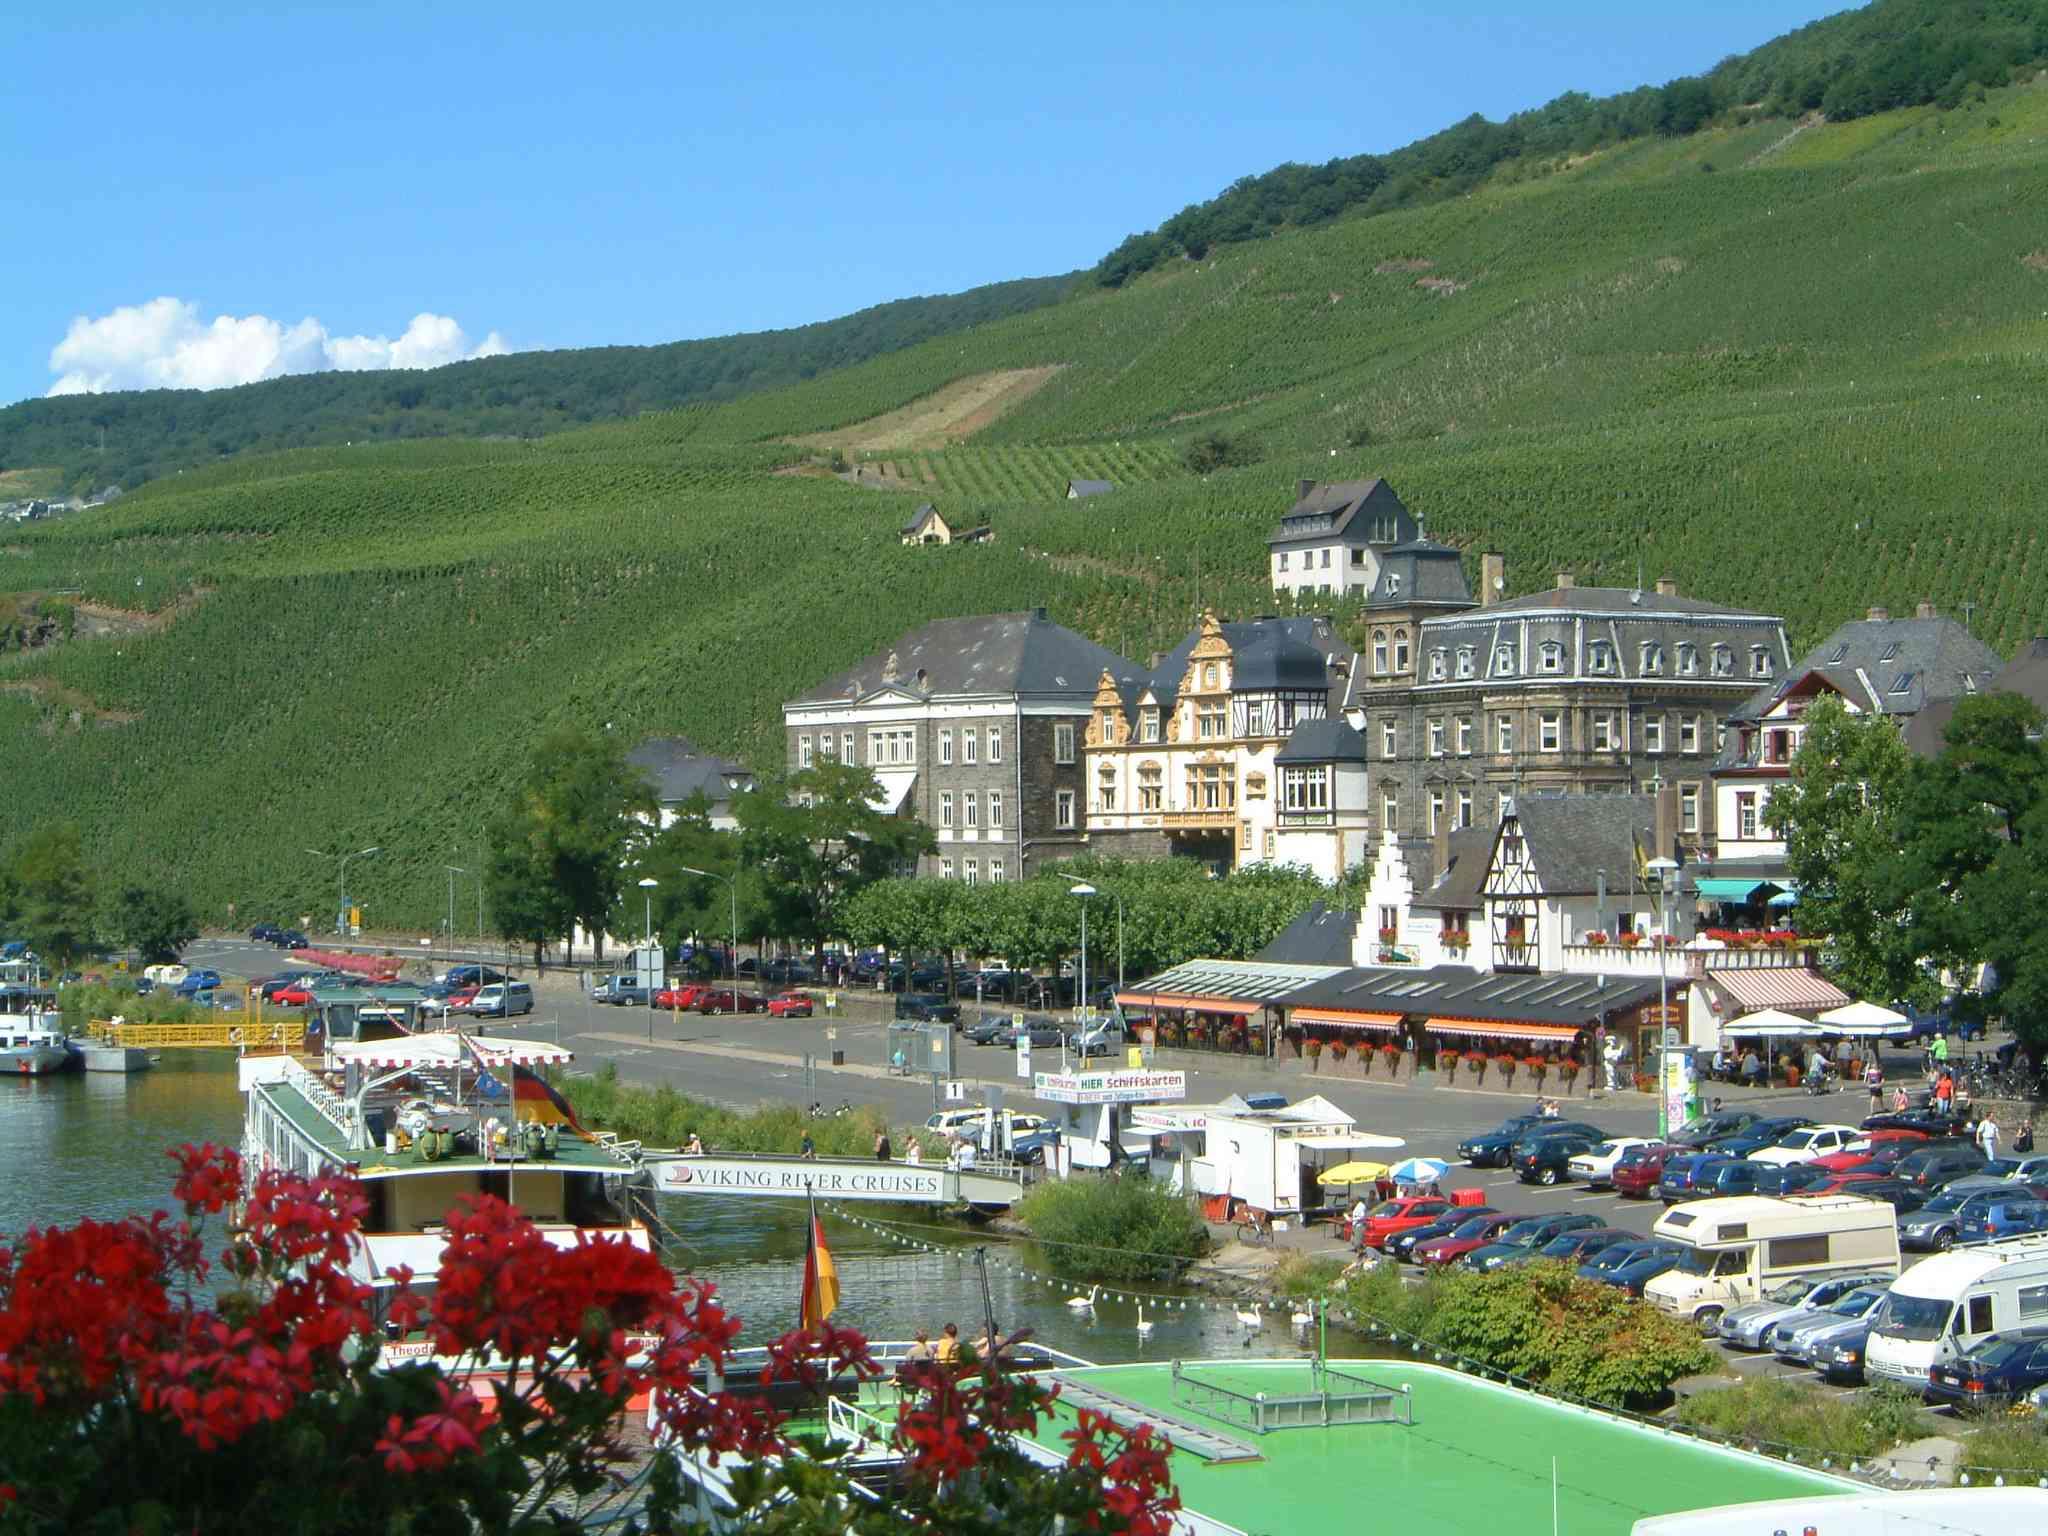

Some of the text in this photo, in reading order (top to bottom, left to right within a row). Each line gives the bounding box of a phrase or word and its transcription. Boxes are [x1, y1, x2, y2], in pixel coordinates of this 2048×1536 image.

[951, 1083, 958, 1097] 1
[1081, 1078, 1103, 1090] HIER
[1107, 1074, 1182, 1089] Schiffskarten
[697, 1168, 937, 1192] VIKING RIVER CRUISES
